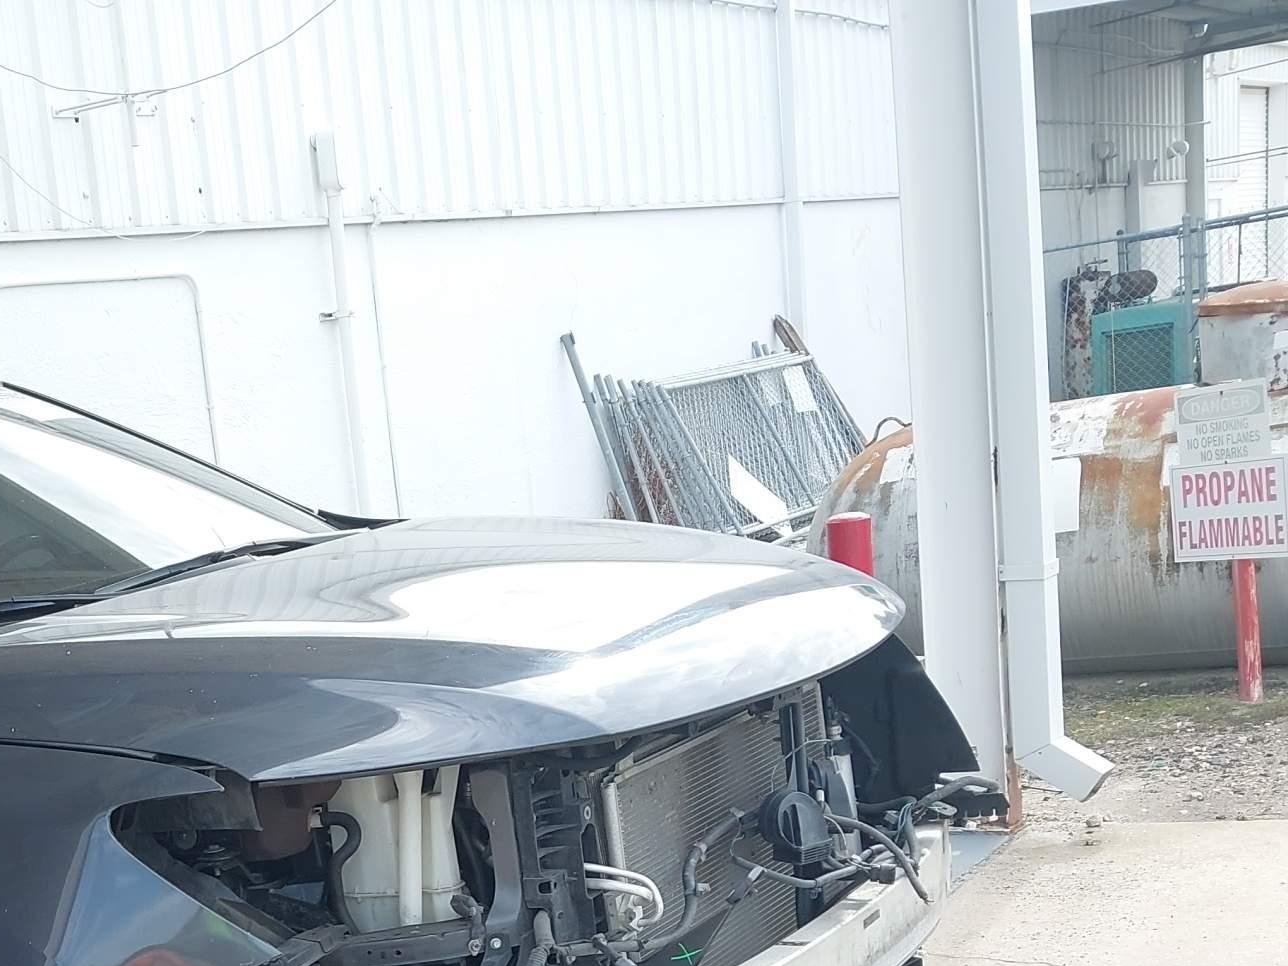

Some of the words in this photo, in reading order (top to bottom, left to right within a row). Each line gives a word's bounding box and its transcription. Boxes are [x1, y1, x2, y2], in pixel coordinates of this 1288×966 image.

[1191, 395, 1250, 415] DANGER
[1196, 423, 1208, 436] NO
[1210, 417, 1249, 433] SMOKING
[1186, 439, 1199, 450] NO
[1200, 434, 1224, 448] OPEN
[1226, 430, 1261, 445] FLAMES
[1200, 450, 1213, 462] NO
[1214, 446, 1249, 460] SPARKS
[1181, 466, 1278, 508] PROPANE
[1178, 514, 1285, 550] FLAMMABLE
